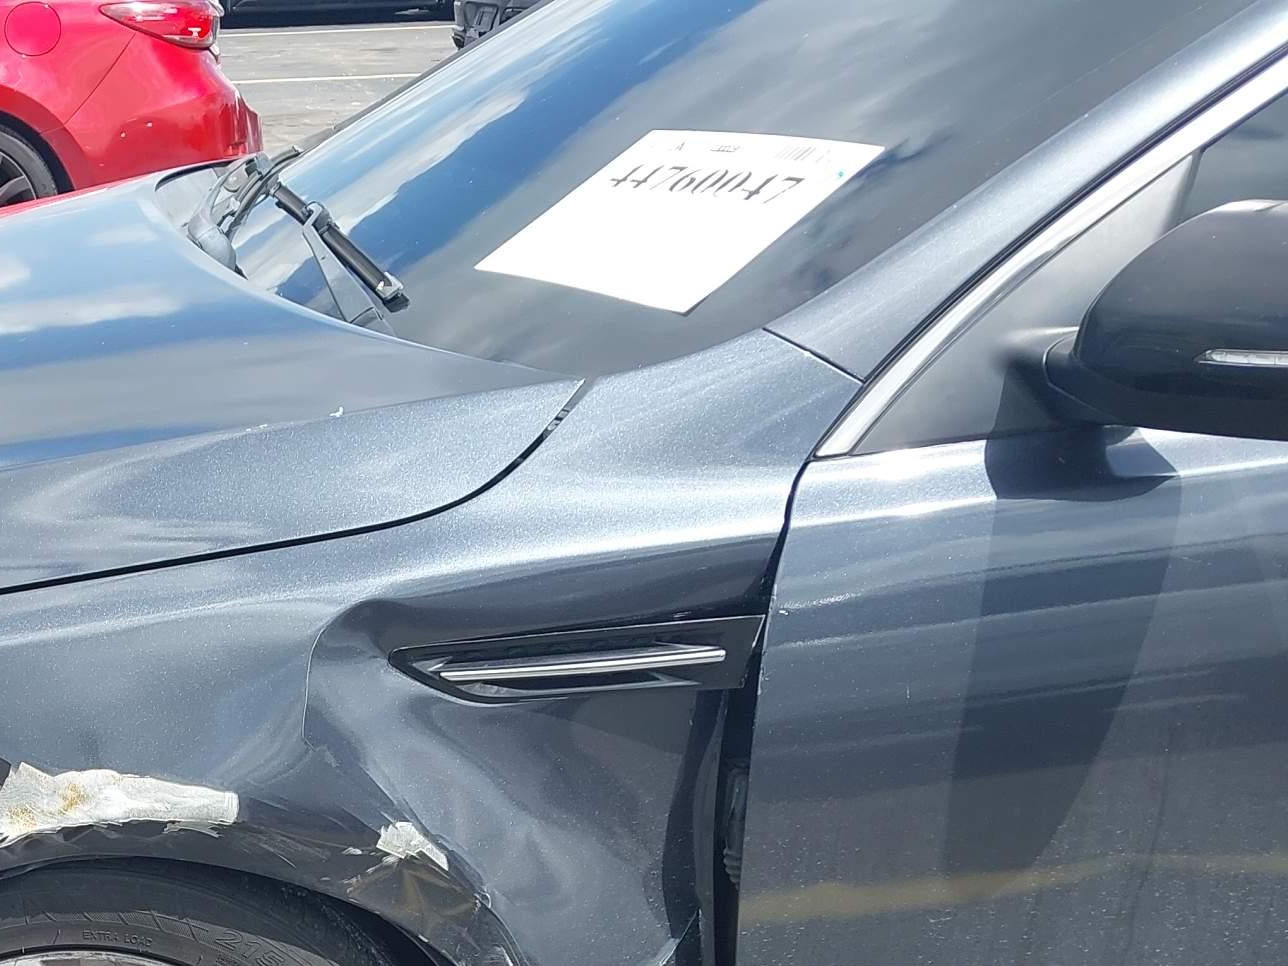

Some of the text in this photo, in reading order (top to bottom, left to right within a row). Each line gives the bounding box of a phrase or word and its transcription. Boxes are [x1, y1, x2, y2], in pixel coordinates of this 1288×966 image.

[610, 163, 806, 204] 44760047
[81, 928, 154, 948] EXTRA LOAD
